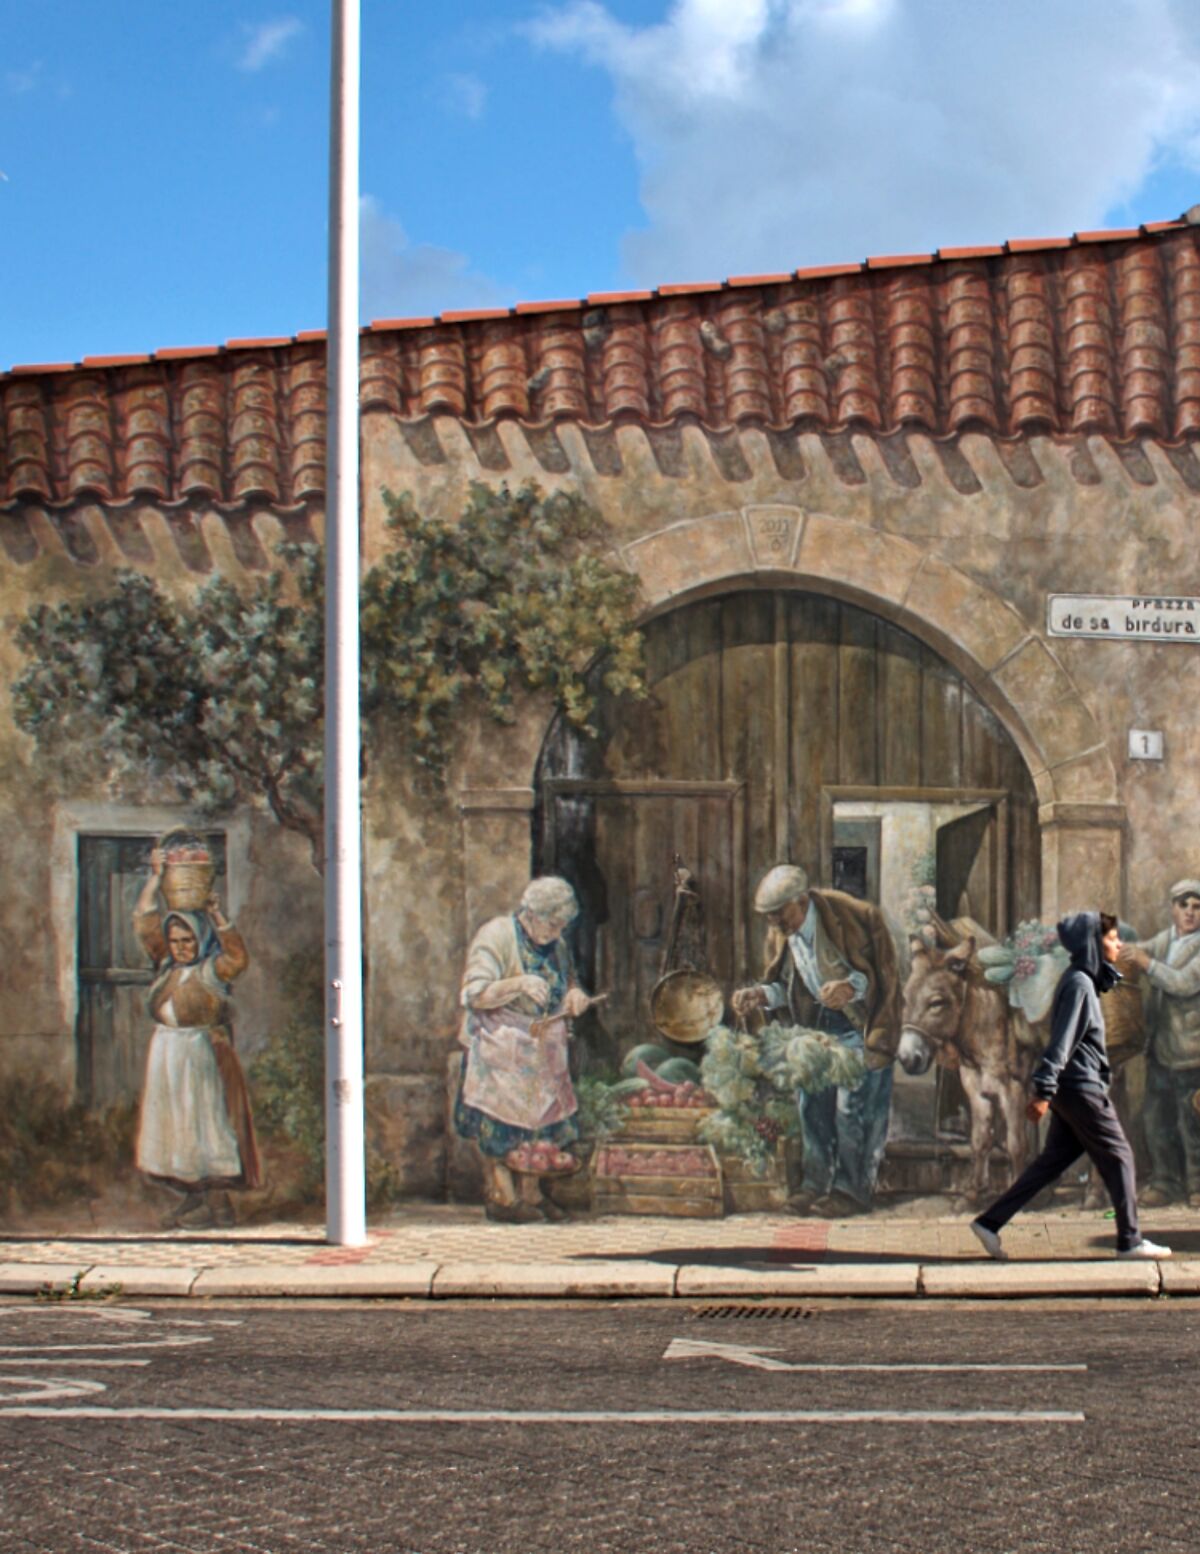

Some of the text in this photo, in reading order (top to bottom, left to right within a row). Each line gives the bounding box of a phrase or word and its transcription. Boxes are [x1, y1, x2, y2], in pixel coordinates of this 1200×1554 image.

[1062, 614, 1196, 635] de sa birdura
[1140, 734, 1149, 755] 1
